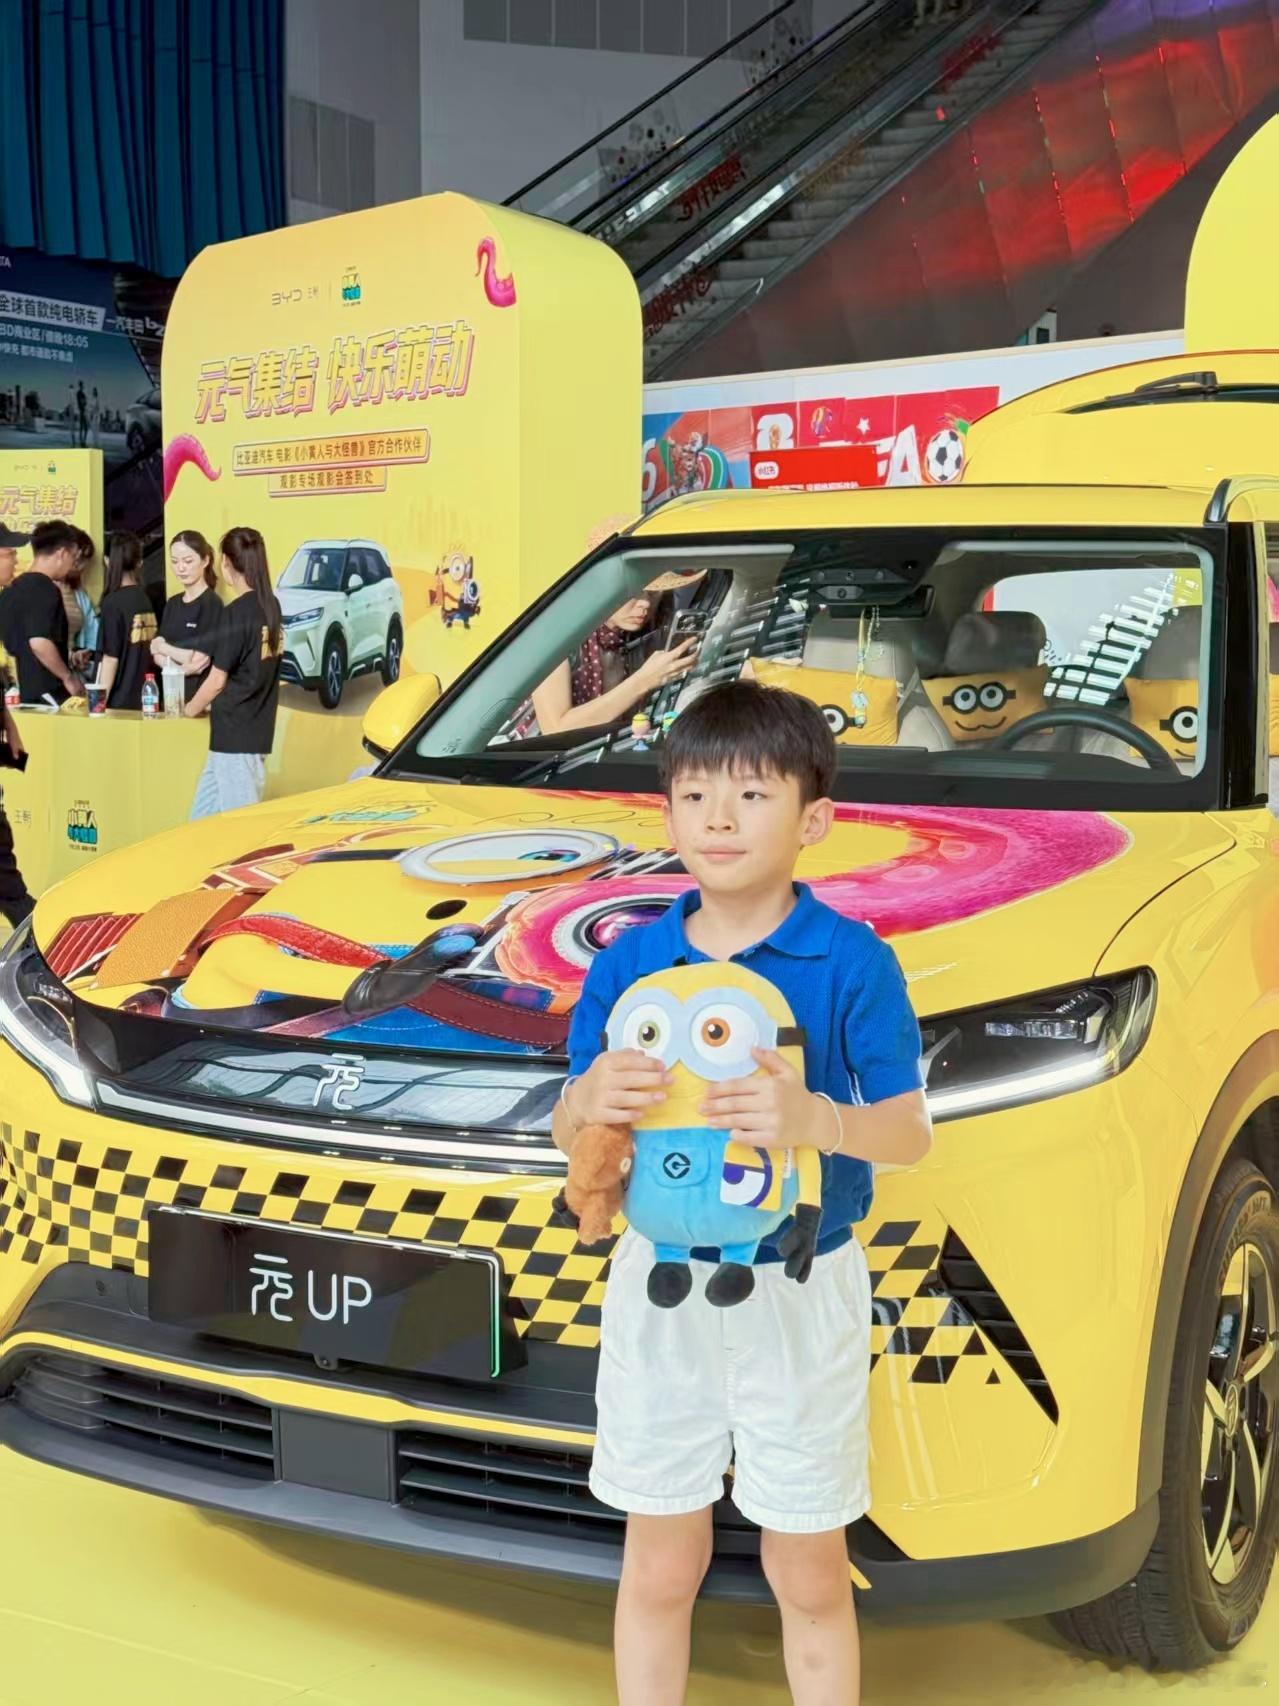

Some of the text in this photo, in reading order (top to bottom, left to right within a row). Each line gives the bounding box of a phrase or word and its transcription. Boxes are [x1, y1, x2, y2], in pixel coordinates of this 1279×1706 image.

[0, 294, 99, 328] 全球首款纯电轿车
[271, 288, 302, 305] BYD
[194, 319, 475, 424] 元气集结 快乐萌动
[236, 448, 273, 465] 比亚迪汽车
[367, 436, 422, 456] 官方合作伙伴
[0, 485, 79, 516] 元气集结
[307, 1269, 372, 1325] UP
